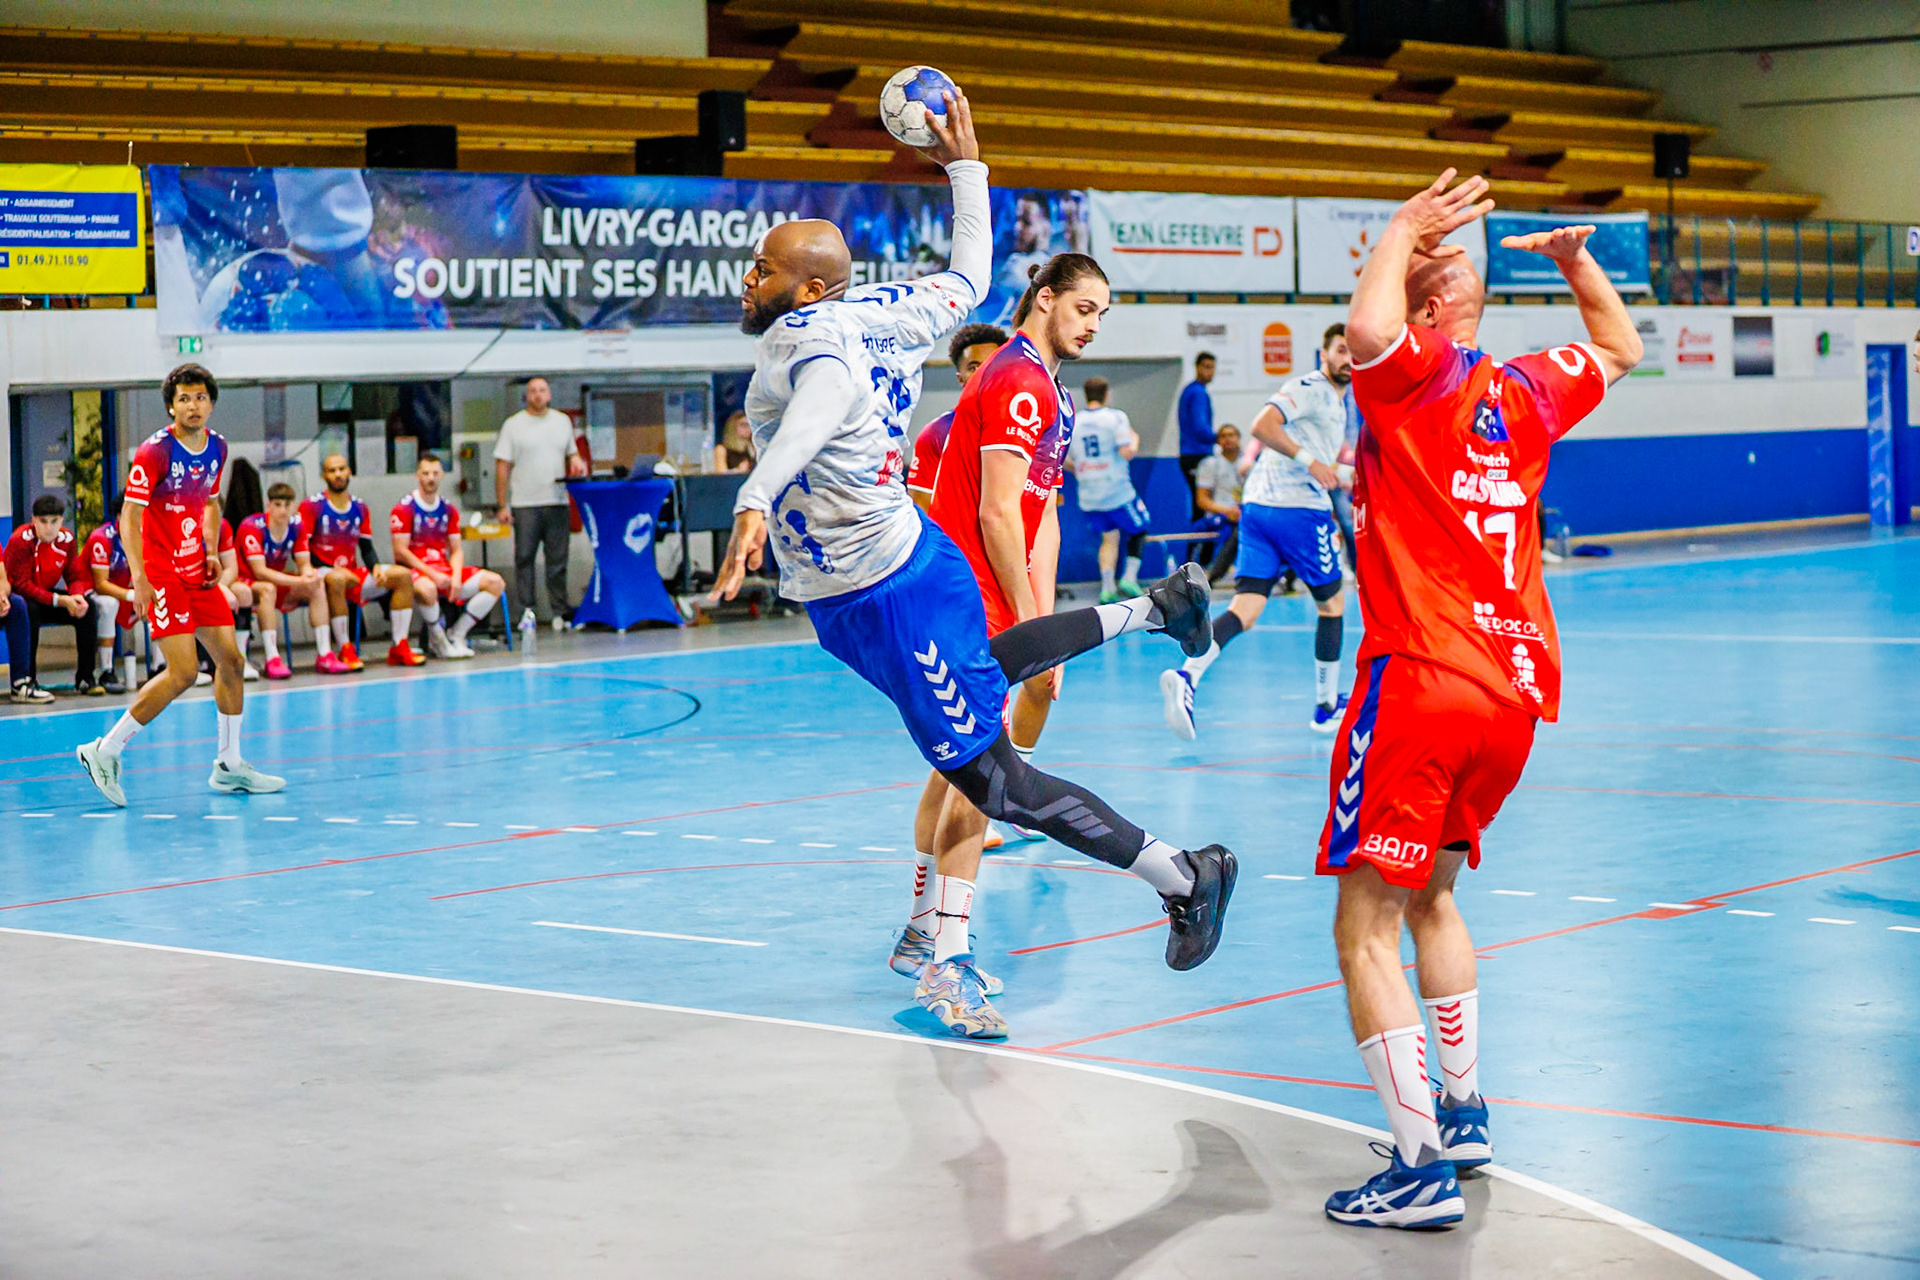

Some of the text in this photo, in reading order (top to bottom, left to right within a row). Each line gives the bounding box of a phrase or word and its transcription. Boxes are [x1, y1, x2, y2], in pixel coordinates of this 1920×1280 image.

[4, 213, 37, 223] TRAVAUX
[1159, 224, 1243, 246] LEFEBVRE
[393, 257, 584, 299] SOUTIENT
[592, 258, 657, 298] SES
[171, 461, 185, 477] 94
